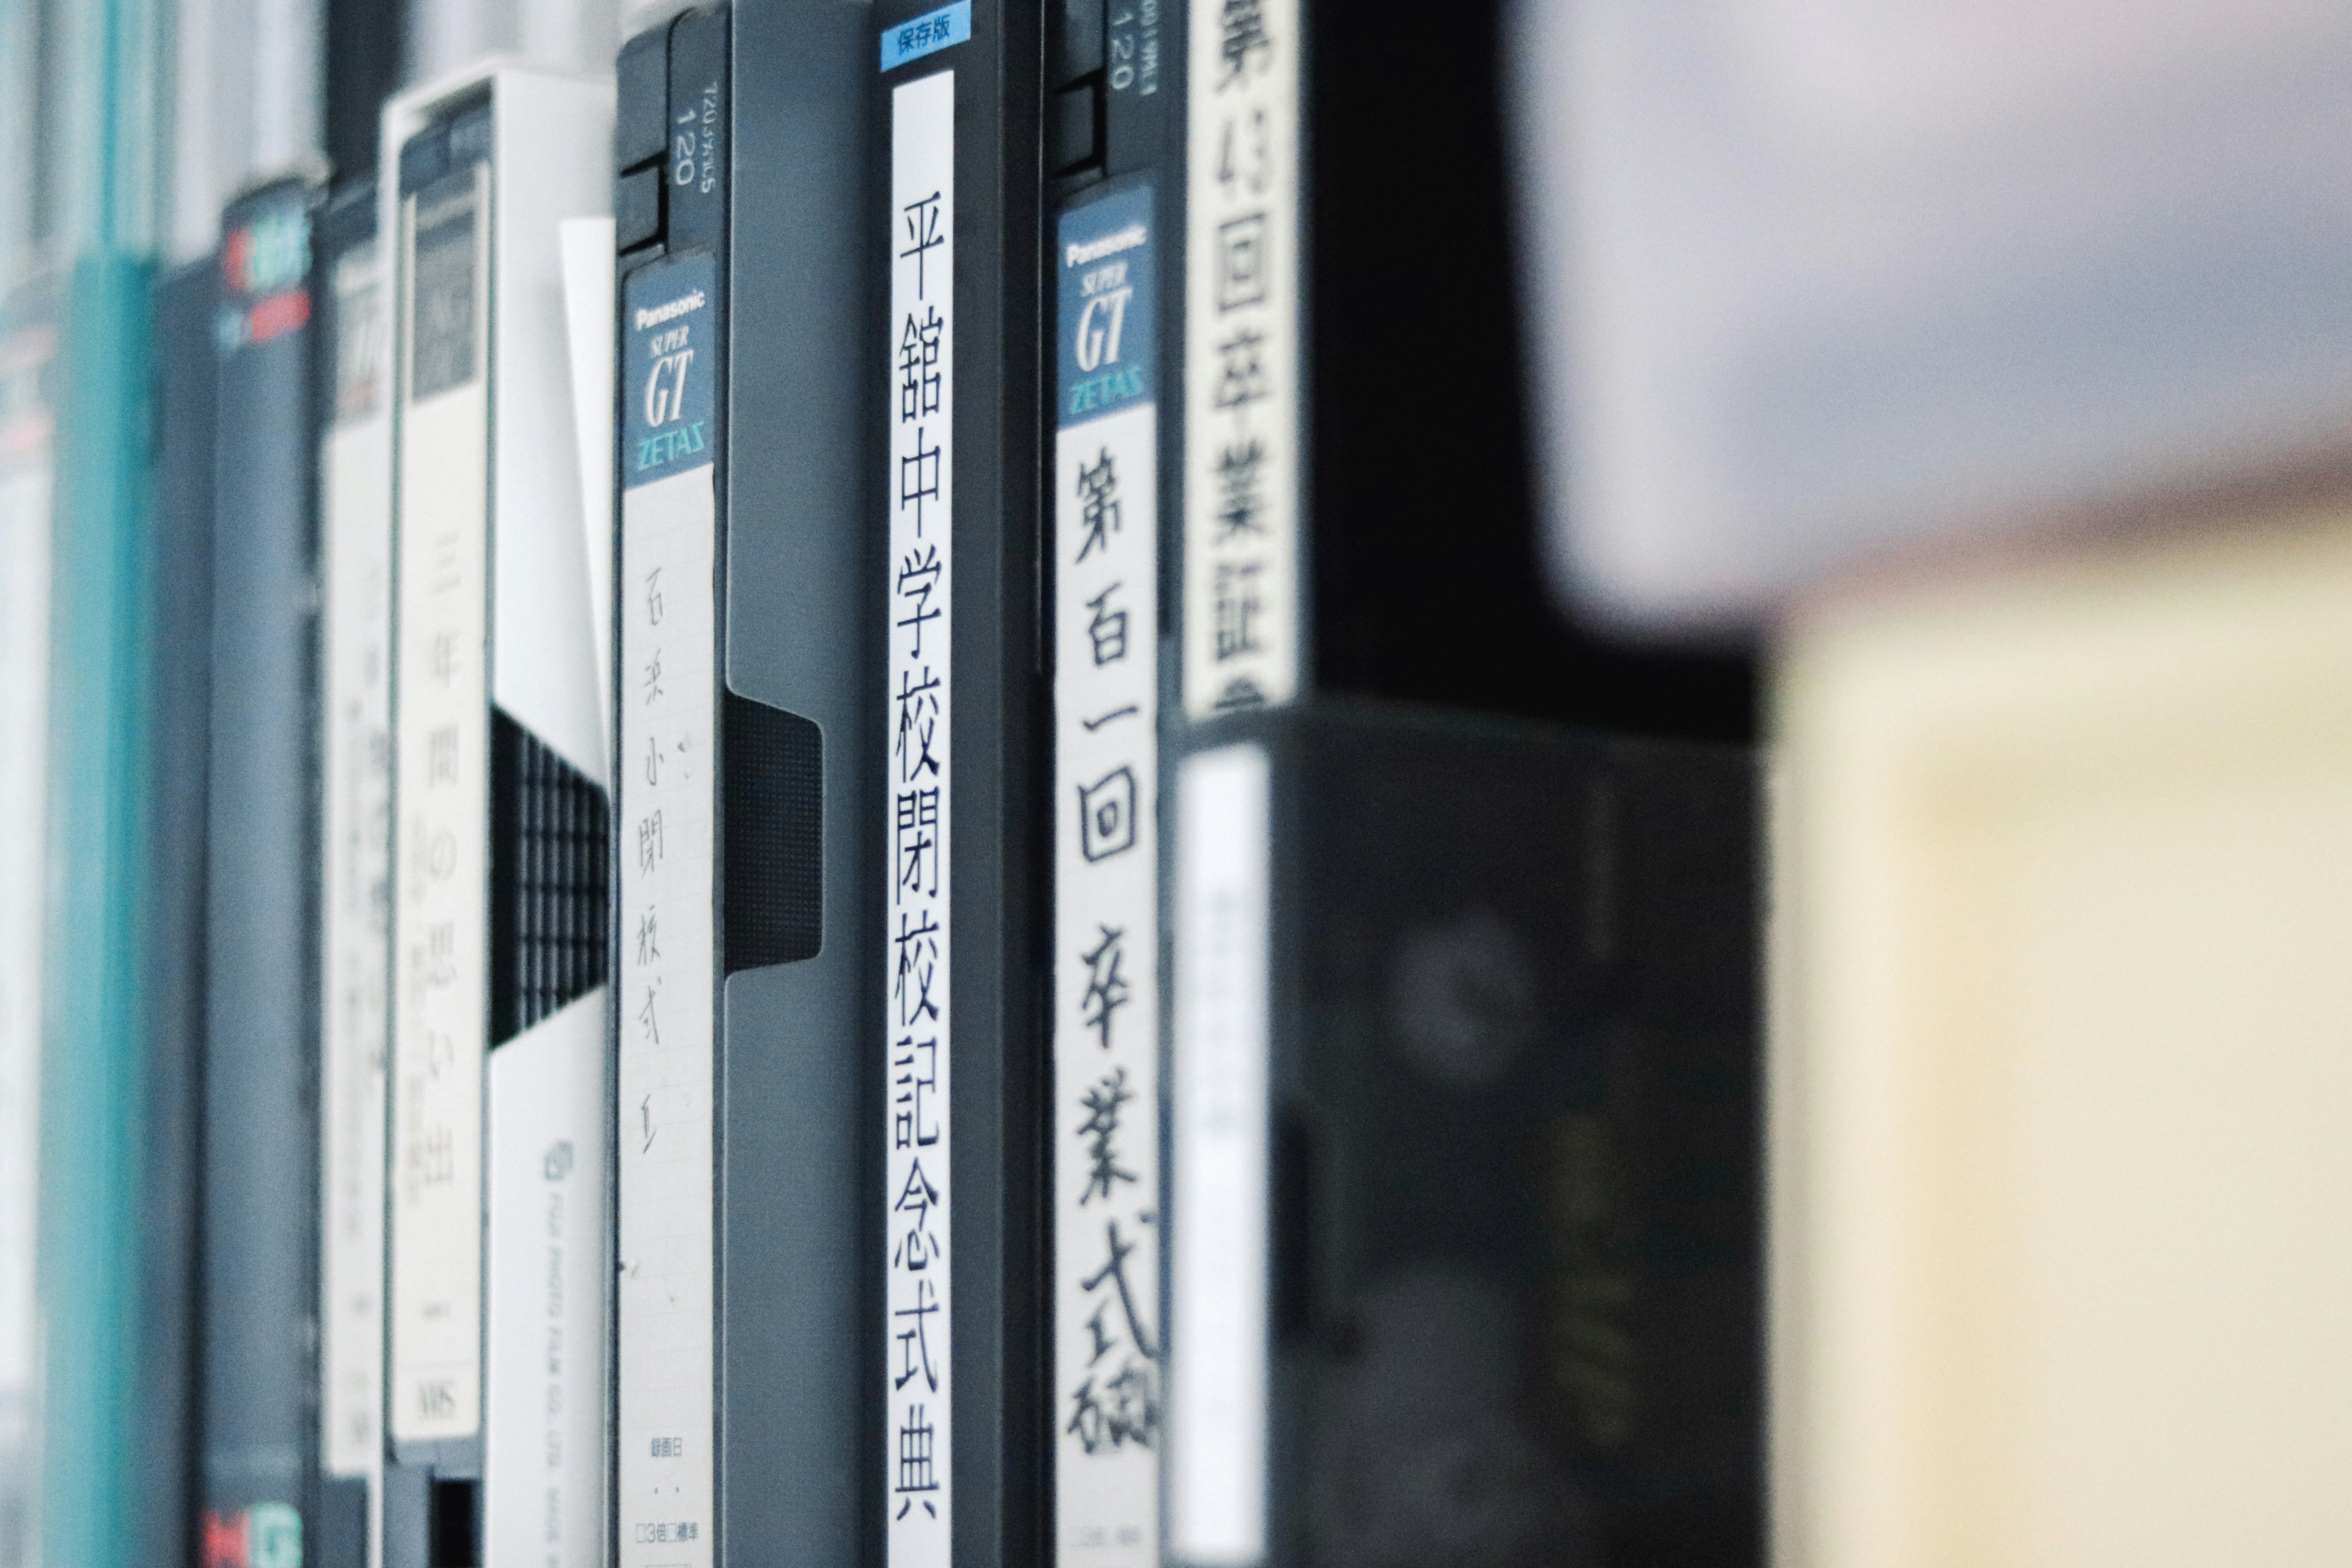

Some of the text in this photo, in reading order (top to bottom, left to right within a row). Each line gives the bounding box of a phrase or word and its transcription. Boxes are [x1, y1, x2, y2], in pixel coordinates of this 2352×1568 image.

[898, 14, 951, 56] 保存版
[1112, 13, 1134, 90] 120
[675, 109, 697, 185] 120
[1066, 223, 1147, 268] Panasonic
[636, 289, 706, 331] Panasonic
[650, 326, 690, 358] SUPER
[1076, 286, 1133, 372] GT
[645, 349, 694, 427] GT
[895, 190, 945, 1521] 平舘中学校閉校記念式典
